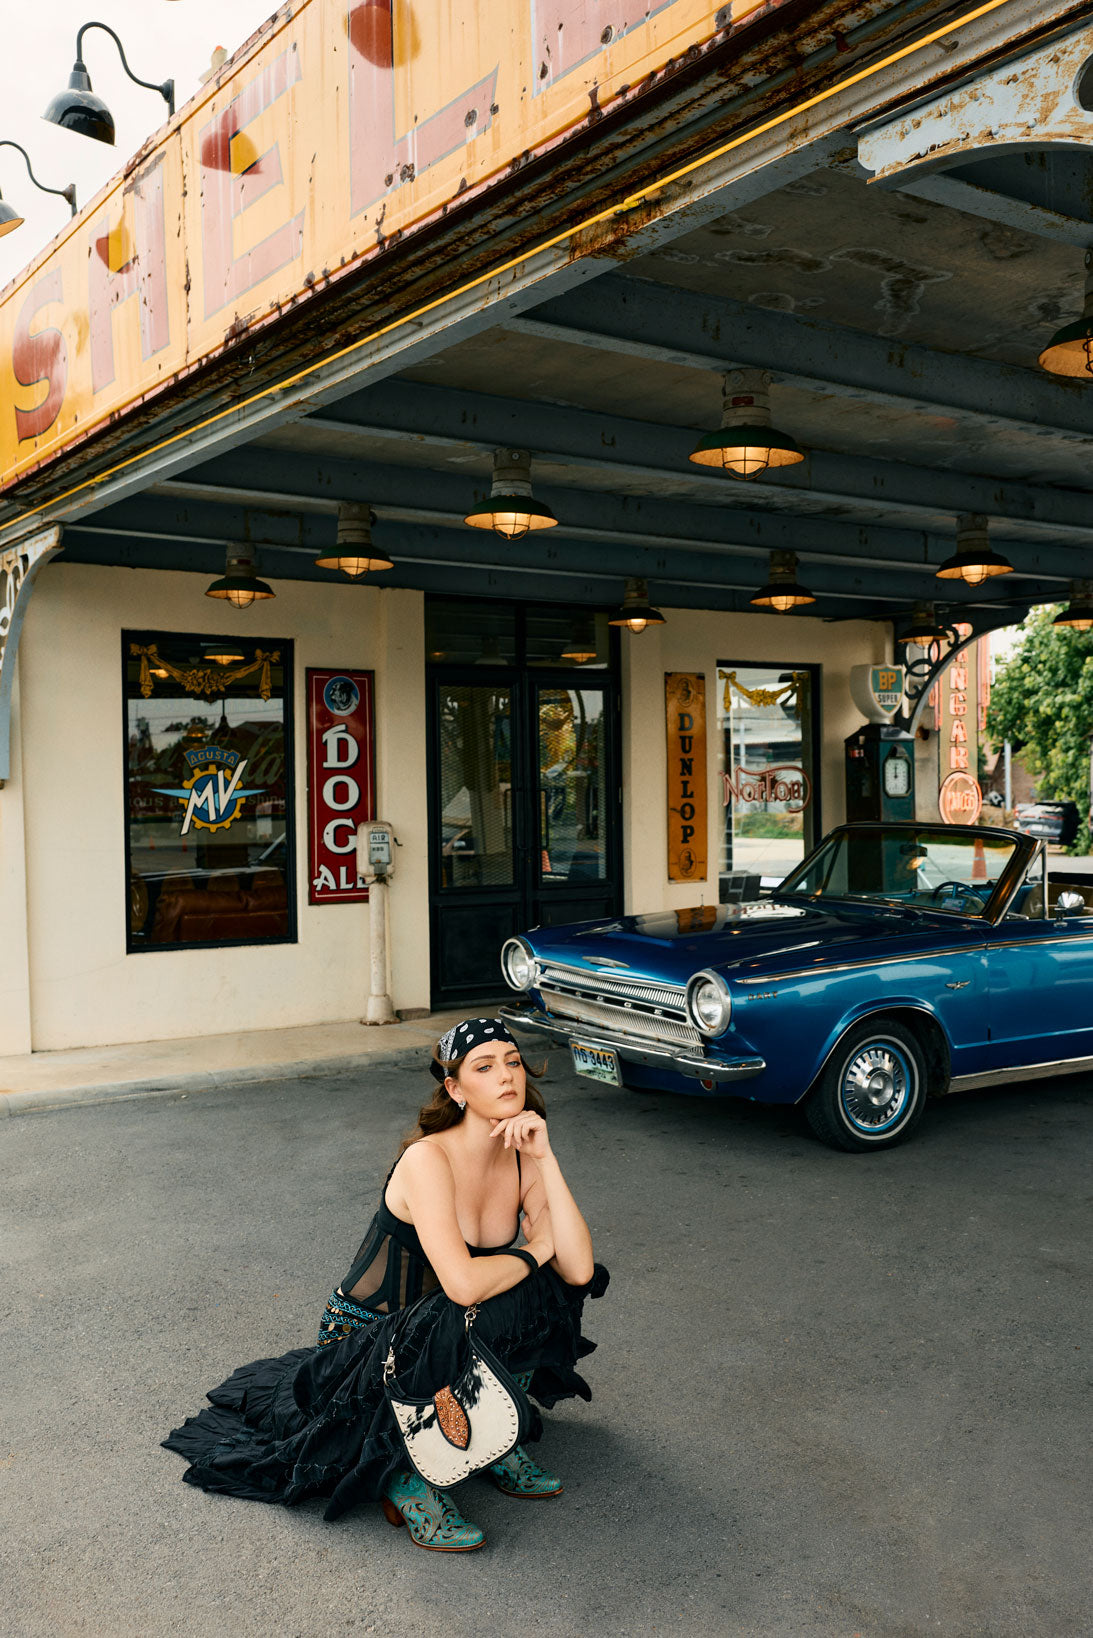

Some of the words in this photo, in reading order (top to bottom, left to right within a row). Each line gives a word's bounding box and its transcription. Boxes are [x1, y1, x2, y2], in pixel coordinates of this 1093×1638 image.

[879, 671, 897, 690] BP
[878, 694, 898, 703] SUPER
[189, 750, 236, 766] AGUSTA
[677, 712, 696, 844] DUNLOP
[180, 759, 248, 837] MV
[322, 723, 361, 855] DOG
[718, 764, 812, 814] Norton
[372, 834, 386, 842] AIR
[748, 990, 778, 1001] DART
[589, 1050, 615, 1071] 3443
